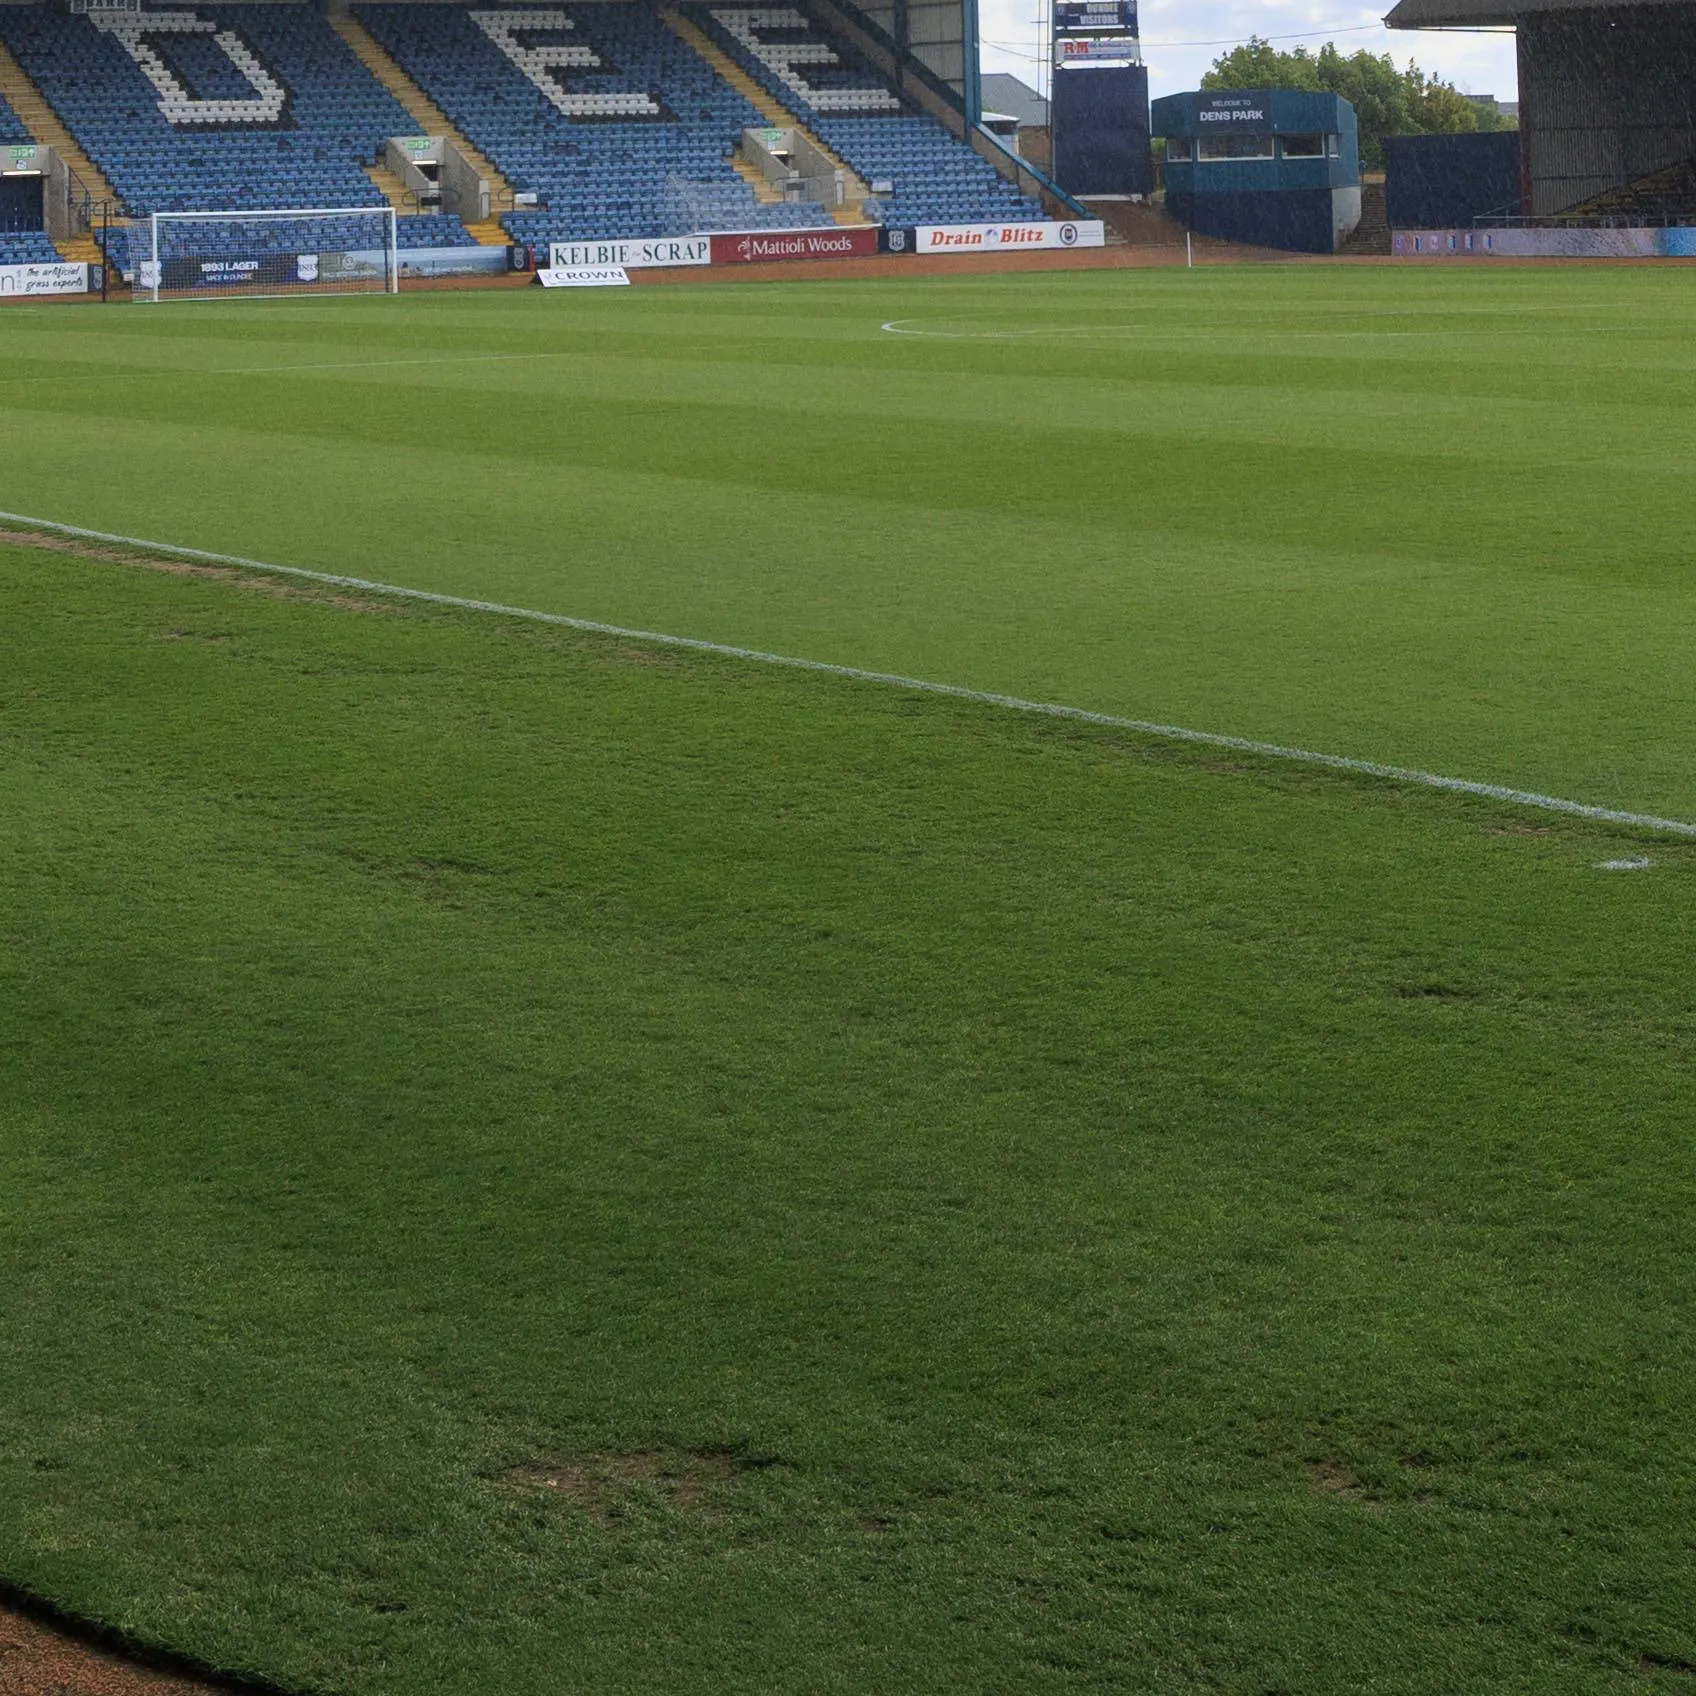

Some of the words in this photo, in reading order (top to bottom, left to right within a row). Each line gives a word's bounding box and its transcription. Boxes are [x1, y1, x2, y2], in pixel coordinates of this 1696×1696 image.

[1200, 111, 1230, 121] DENS
[1232, 110, 1263, 120] PARK
[930, 231, 982, 246] Drain
[1000, 228, 1043, 243] Blitz
[754, 238, 804, 255] Mattioli
[808, 235, 852, 252] Woods
[555, 244, 630, 266] KELBIE
[642, 241, 707, 262] SCRAP
[226, 261, 259, 271] LAGER
[555, 270, 624, 280] CROWN
[26, 279, 49, 292] grass
[53, 277, 83, 290] experts
